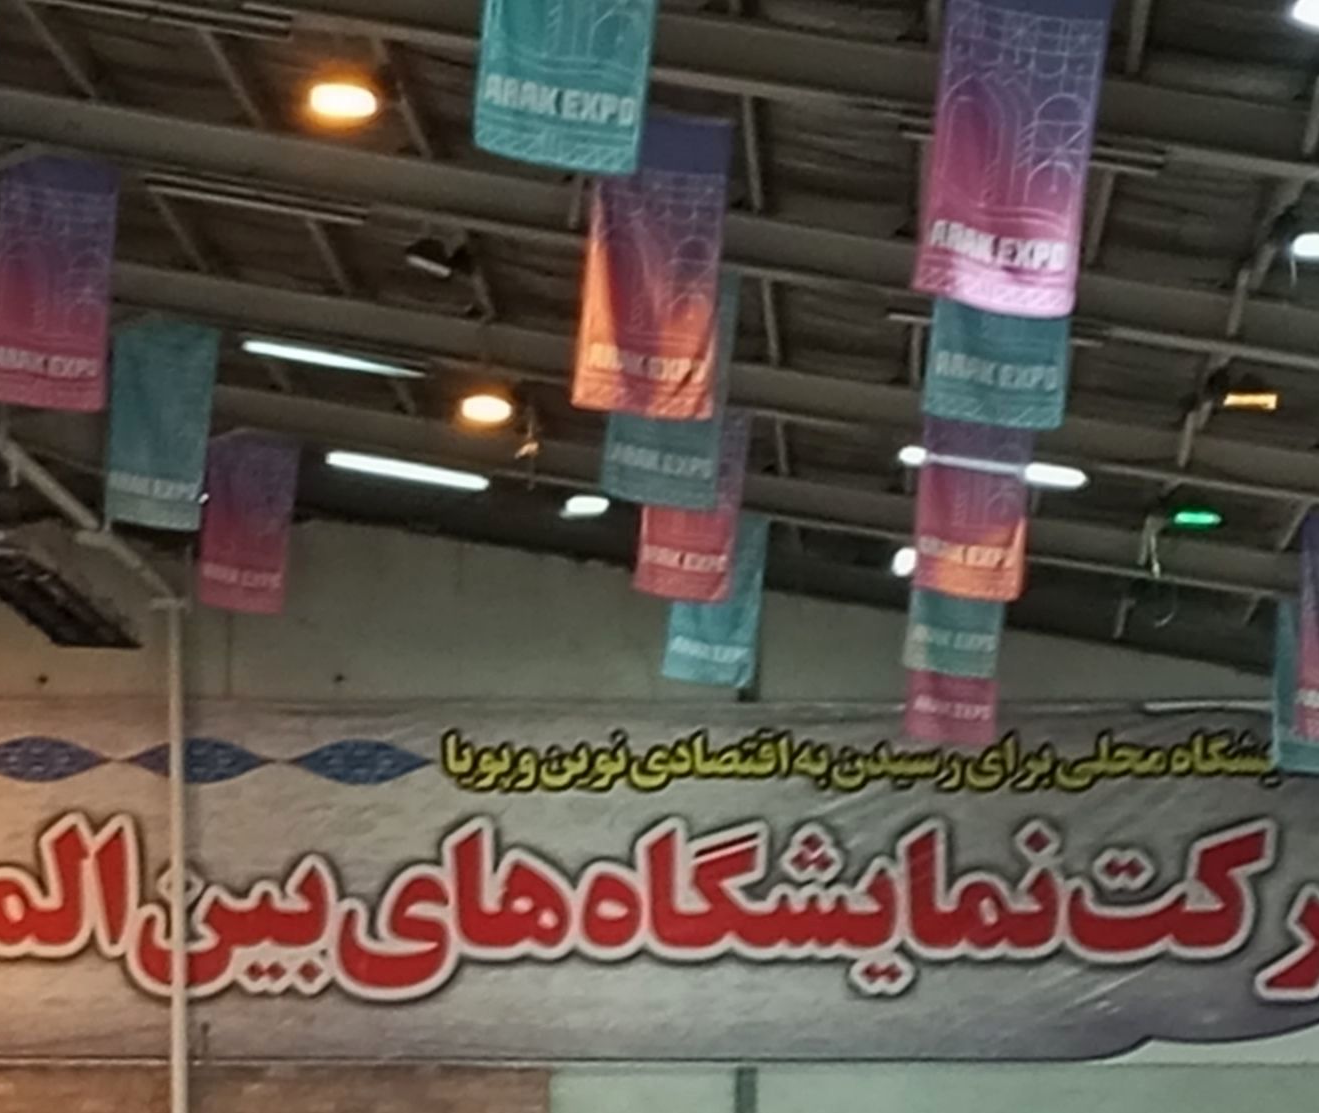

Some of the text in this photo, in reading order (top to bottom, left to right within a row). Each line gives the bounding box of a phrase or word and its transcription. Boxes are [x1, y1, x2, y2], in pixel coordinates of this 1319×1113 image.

[484, 74, 634, 126] ARAK EXPO
[931, 219, 1067, 270] ARAK EXPO
[935, 350, 1058, 391] ARAK EXPO
[441, 728, 511, 792] پویا
[538, 728, 630, 792] نوین
[628, 727, 793, 792] اقتصادی
[792, 738, 832, 791] به
[830, 740, 963, 792] رسیدن
[963, 729, 1056, 793] برای
[1055, 727, 1169, 793] محلی
[131, 855, 341, 998] بین
